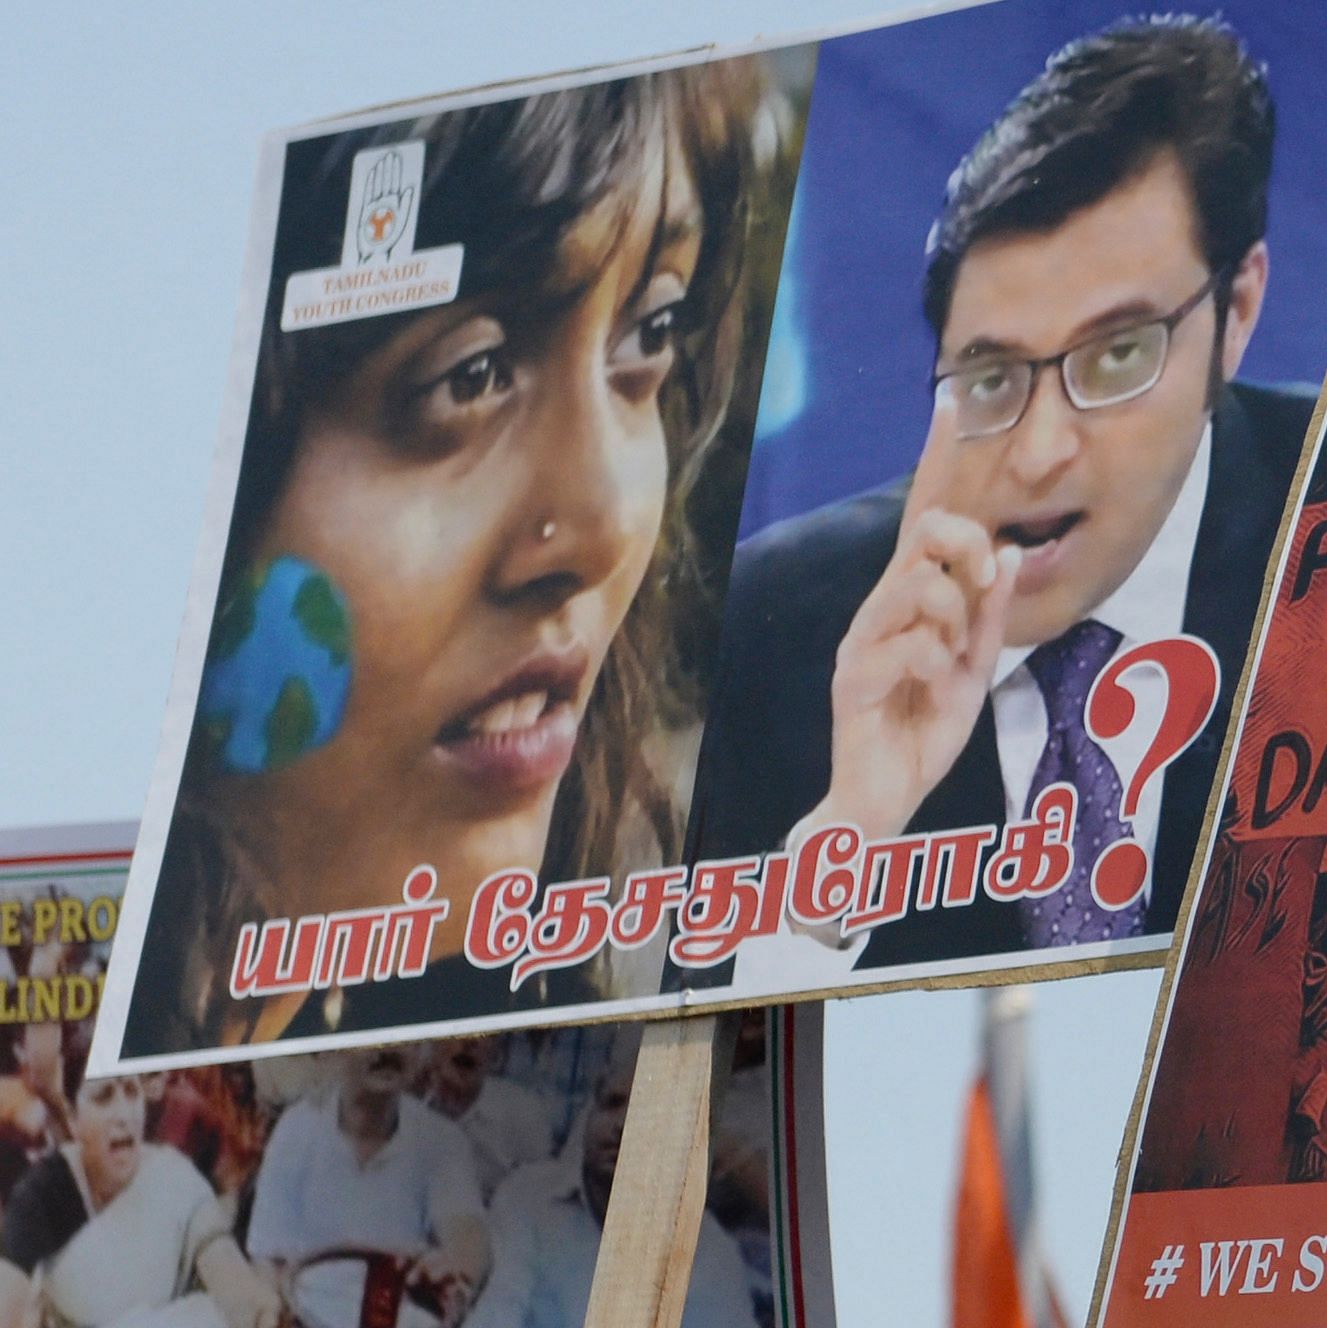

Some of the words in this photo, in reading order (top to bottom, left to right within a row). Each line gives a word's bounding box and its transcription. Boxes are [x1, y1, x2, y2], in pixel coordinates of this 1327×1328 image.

[323, 261, 428, 294] TAMILNADU
[355, 281, 450, 312] CONGRESS
[33, 895, 126, 943] PRO
[0, 973, 107, 1024] LIND
[1198, 1237, 1285, 1296] WE
